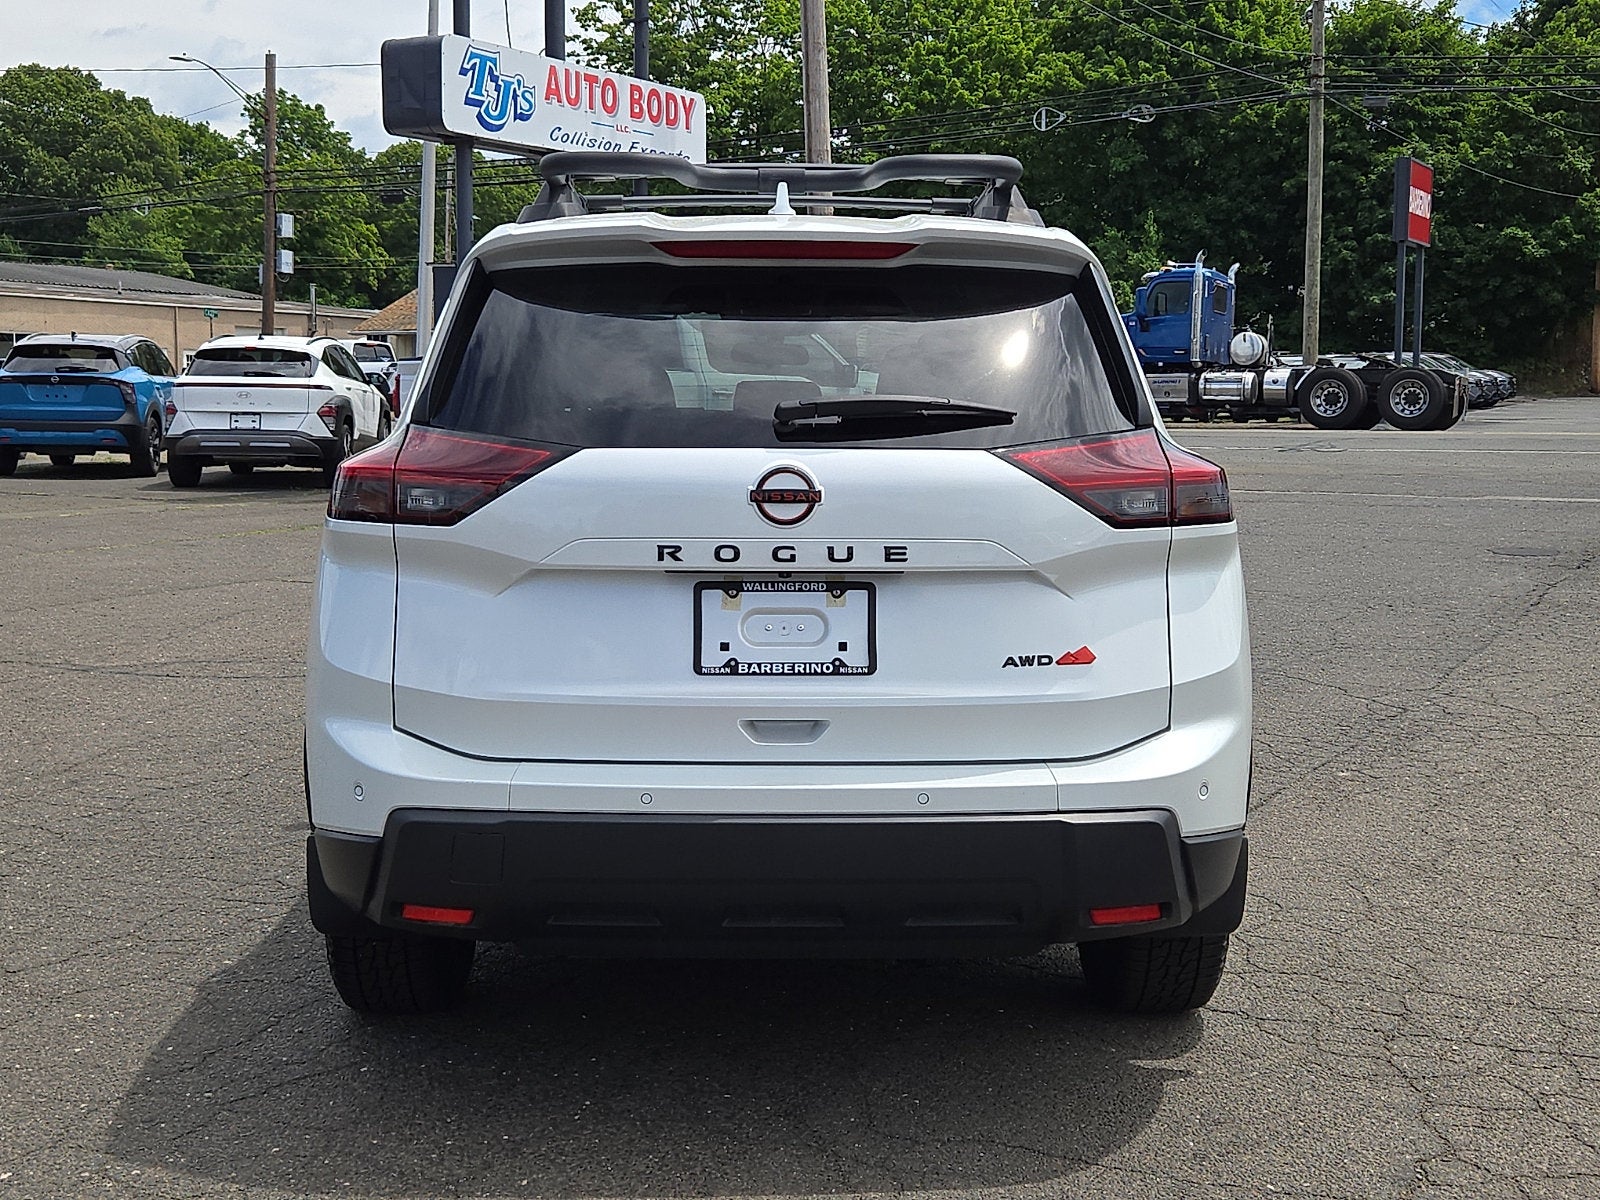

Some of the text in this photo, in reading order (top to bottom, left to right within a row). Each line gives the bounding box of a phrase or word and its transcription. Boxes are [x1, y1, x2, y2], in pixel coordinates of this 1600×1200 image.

[459, 44, 696, 132] TJ's AUTO BODY
[550, 126, 622, 152] Collision
[751, 491, 820, 502] NISSAN
[657, 545, 908, 562] ROGUE
[742, 582, 827, 591] WALLINGFORD
[738, 662, 834, 674] BARBERINO
[1001, 654, 1054, 668] AWD
